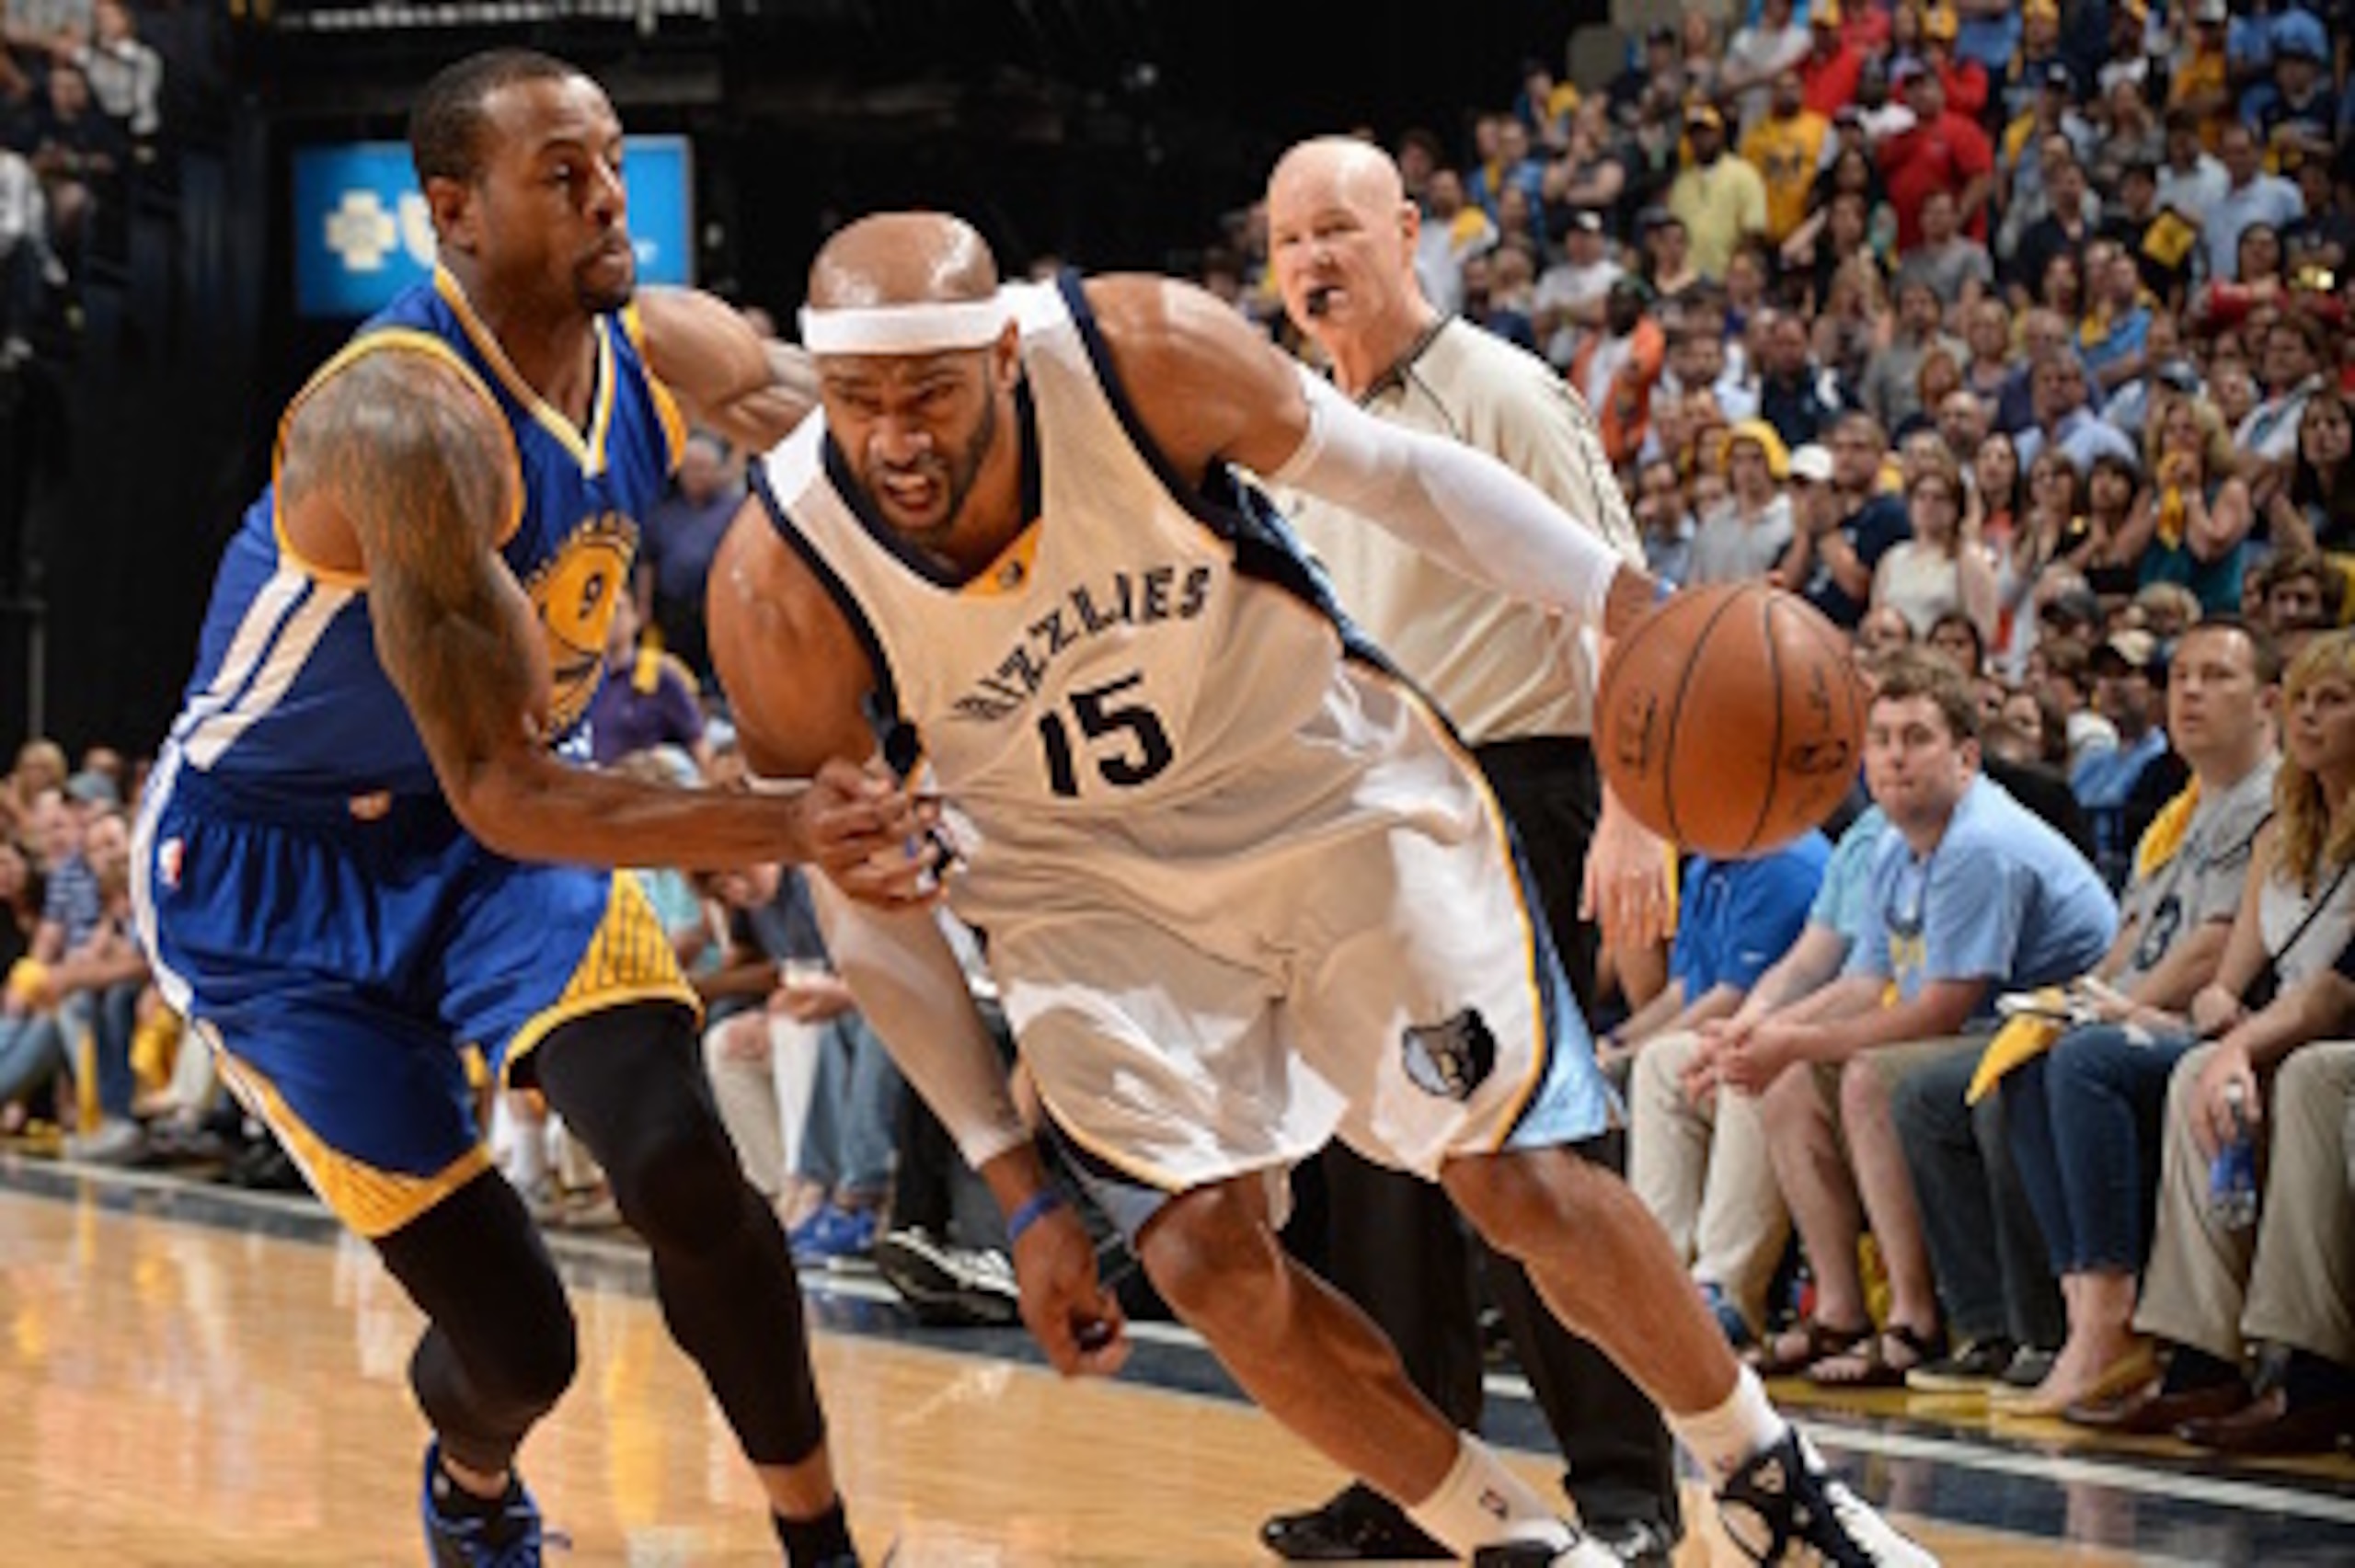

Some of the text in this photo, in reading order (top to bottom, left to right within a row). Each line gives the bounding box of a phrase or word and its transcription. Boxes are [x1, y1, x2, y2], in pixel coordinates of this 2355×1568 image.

[578, 573, 604, 619] 9
[953, 566, 1211, 720] RIZZLIES
[1039, 671, 1173, 797] 15
